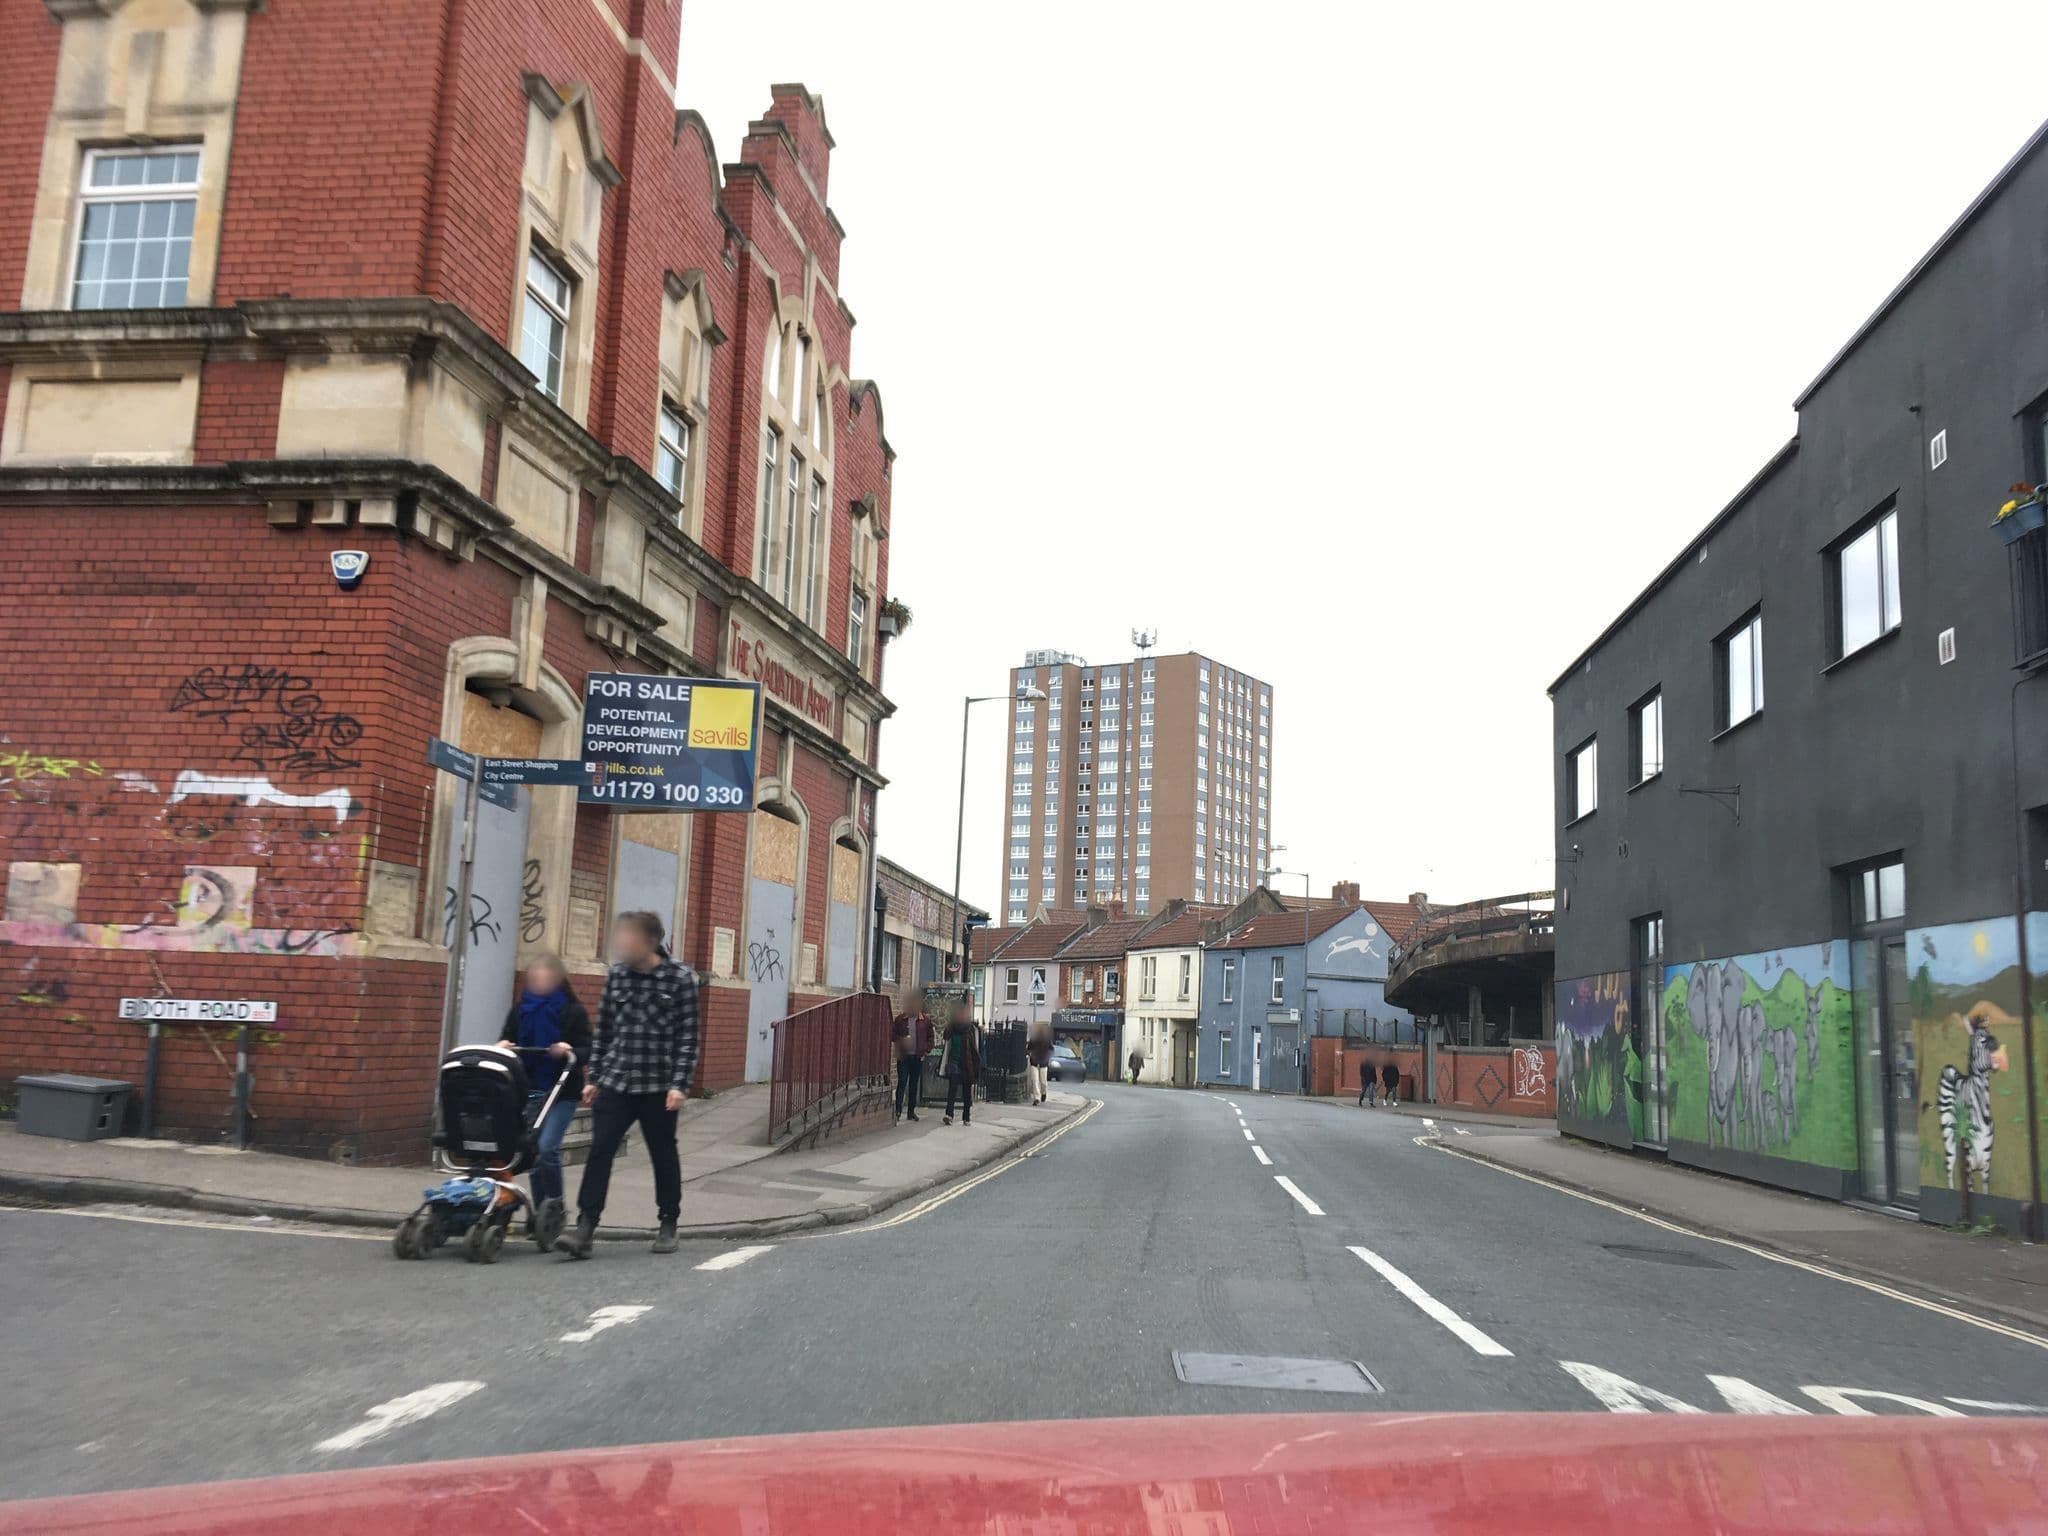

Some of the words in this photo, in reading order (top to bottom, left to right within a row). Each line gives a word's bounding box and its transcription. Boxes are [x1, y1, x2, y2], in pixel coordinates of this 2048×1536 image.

[589, 679, 632, 698] FOR
[637, 682, 690, 701] SALE
[600, 708, 674, 723] POTENTIAL
[587, 724, 687, 740] DEVELOPMENT
[692, 727, 748, 747] savills
[588, 740, 682, 756] OPPORTUNITY
[484, 760, 501, 768] East
[502, 761, 523, 769] Street
[524, 761, 559, 771] Shopping
[484, 772, 499, 781] City
[593, 780, 655, 799] 01179
[662, 783, 699, 802] 100
[705, 787, 743, 805] 330
[200, 1002, 250, 1019] ROAD
